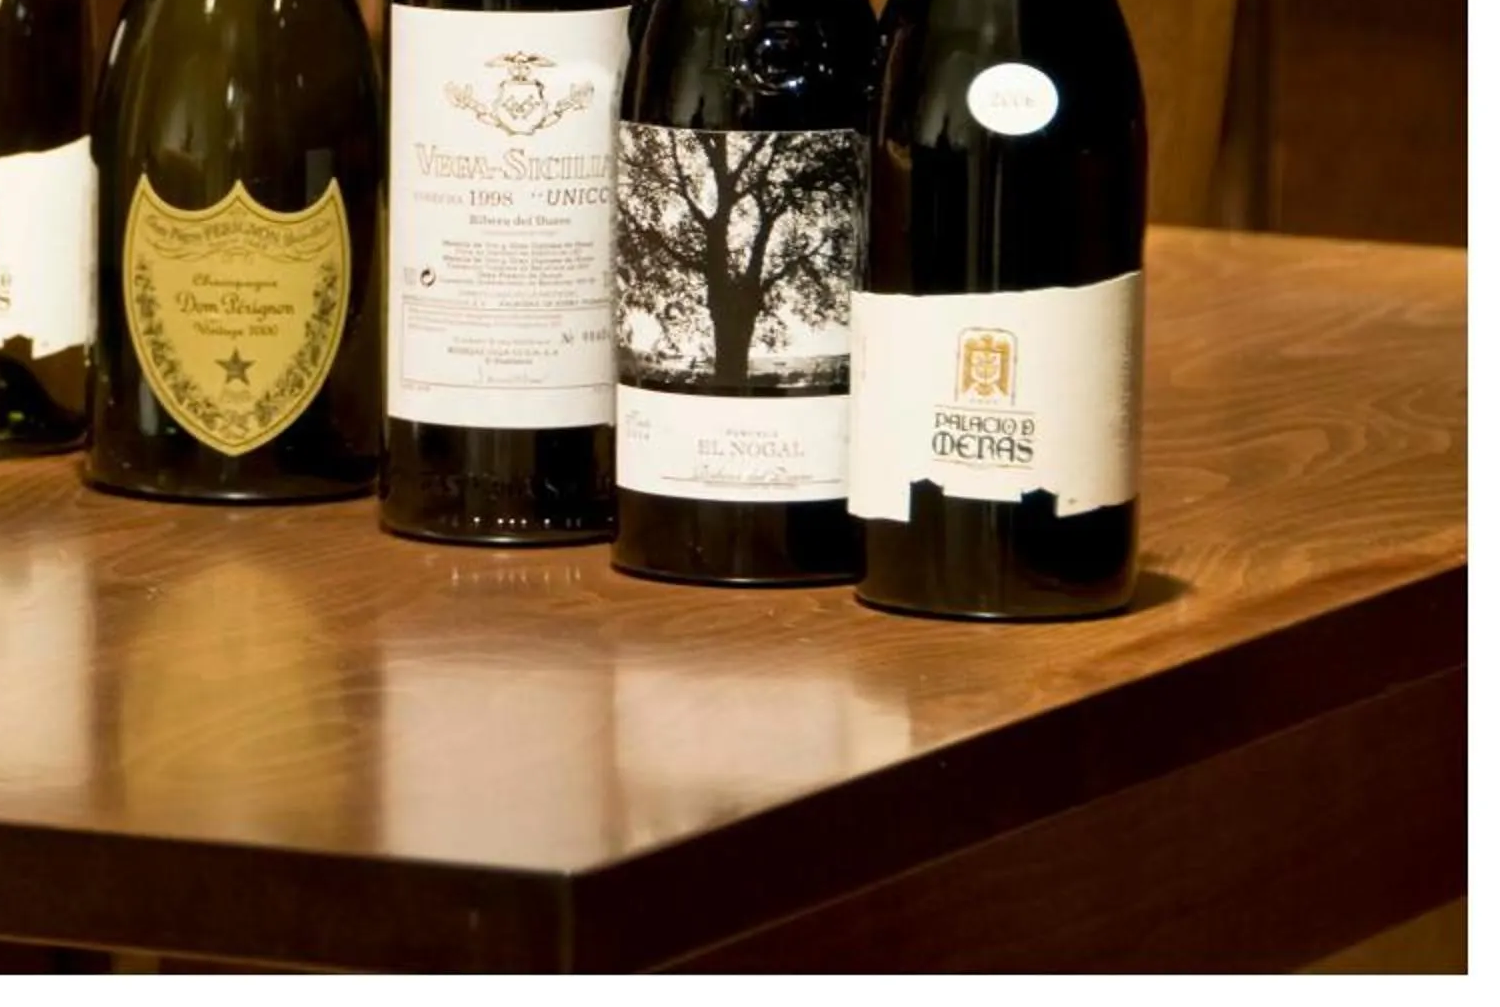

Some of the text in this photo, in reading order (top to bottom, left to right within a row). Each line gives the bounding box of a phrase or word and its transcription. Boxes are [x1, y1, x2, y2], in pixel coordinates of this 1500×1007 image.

[469, 189, 513, 207] 1998
[175, 292, 218, 314] Dom
[934, 412, 1017, 435] PALACIO
[696, 439, 805, 458] EL NOGAL
